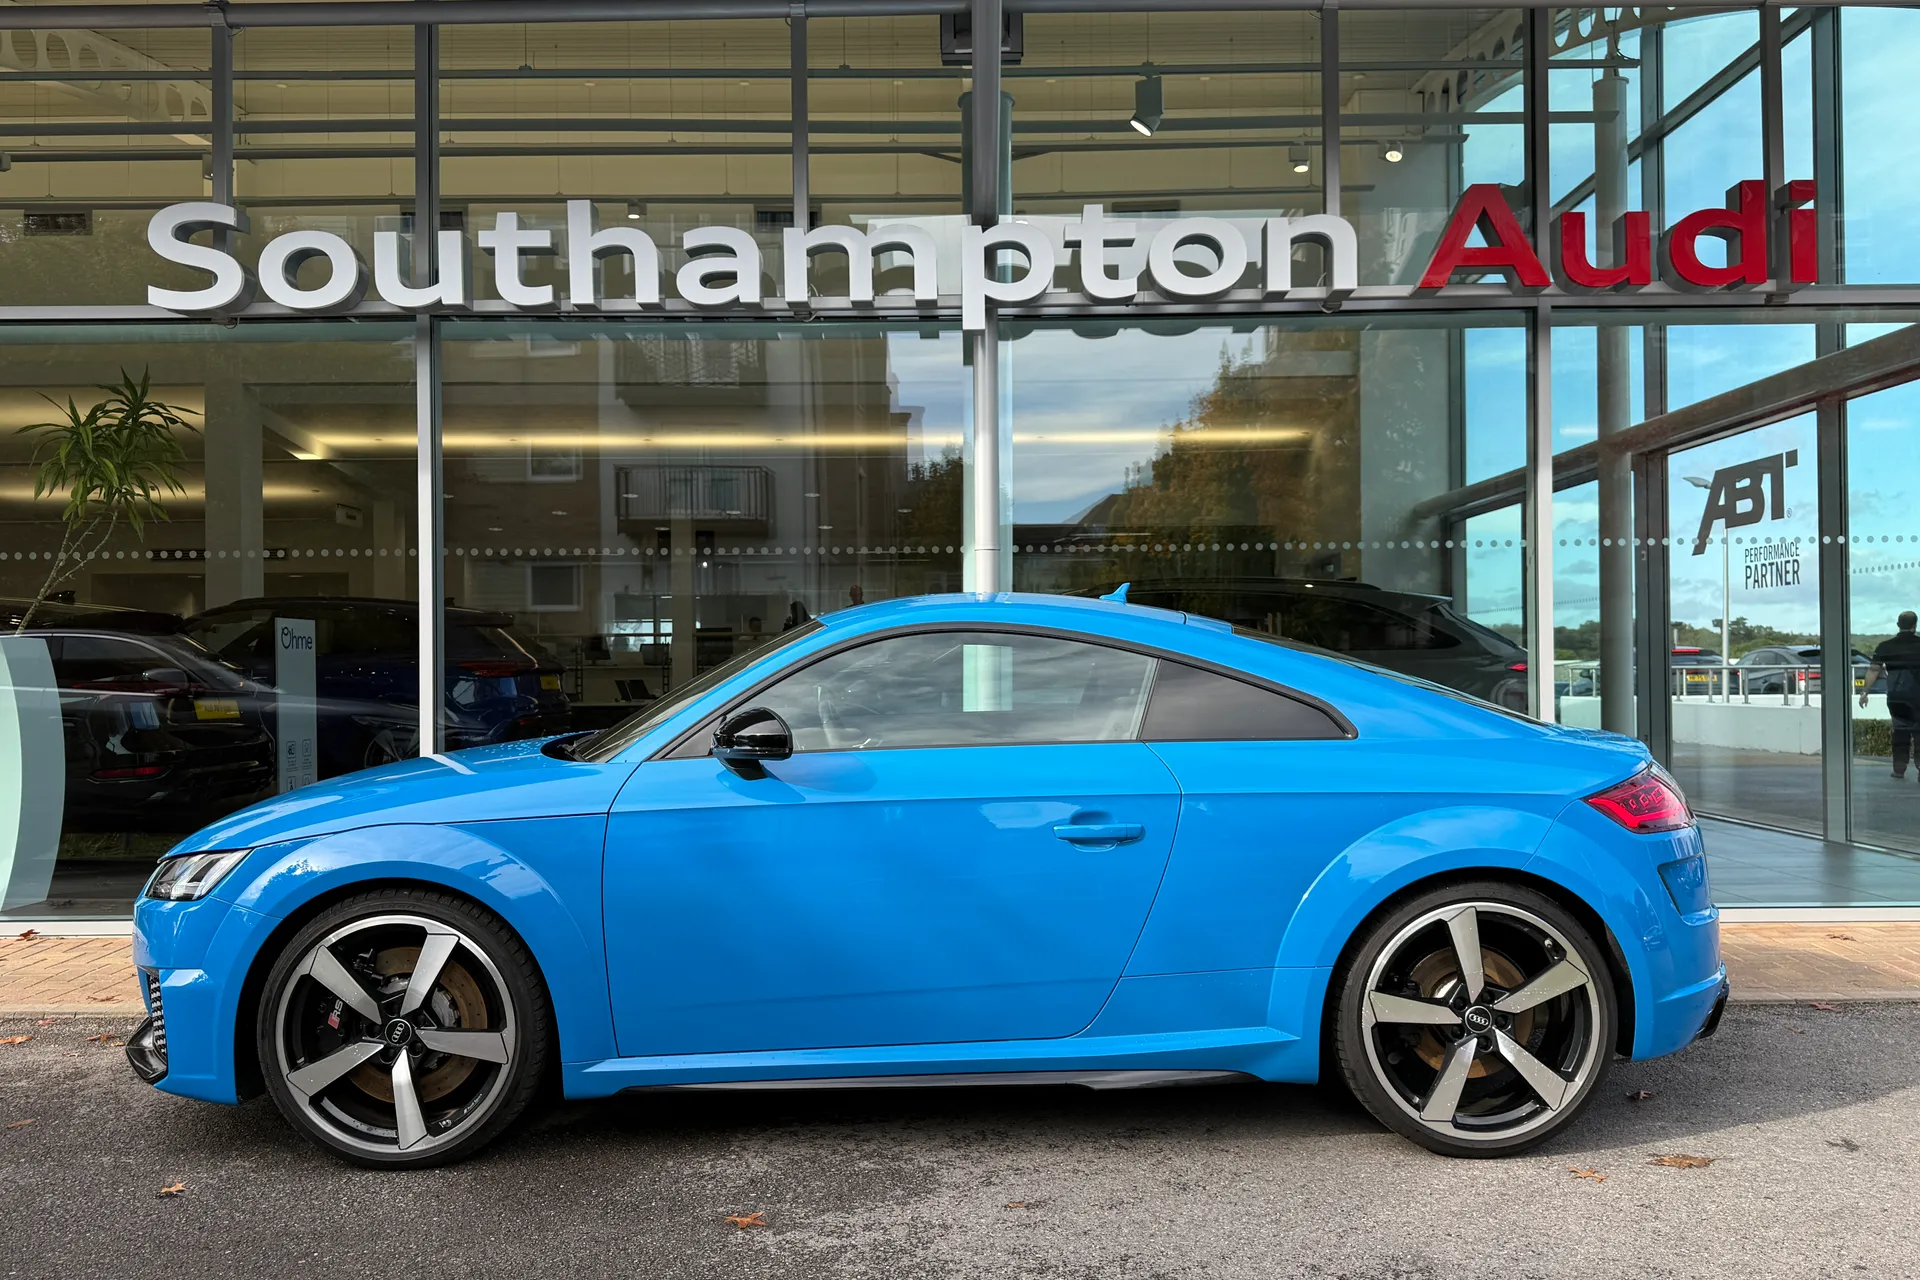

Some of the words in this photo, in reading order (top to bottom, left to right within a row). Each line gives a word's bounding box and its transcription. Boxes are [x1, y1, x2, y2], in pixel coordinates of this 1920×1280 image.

[147, 199, 1358, 331] Southampton
[1418, 179, 1818, 289] Audi
[1692, 449, 1798, 556] ABT
[1745, 541, 1800, 563] PERFORMANCE
[1745, 559, 1800, 590] PARTNER
[281, 626, 313, 650] Ohme
[332, 999, 344, 1020] RS
